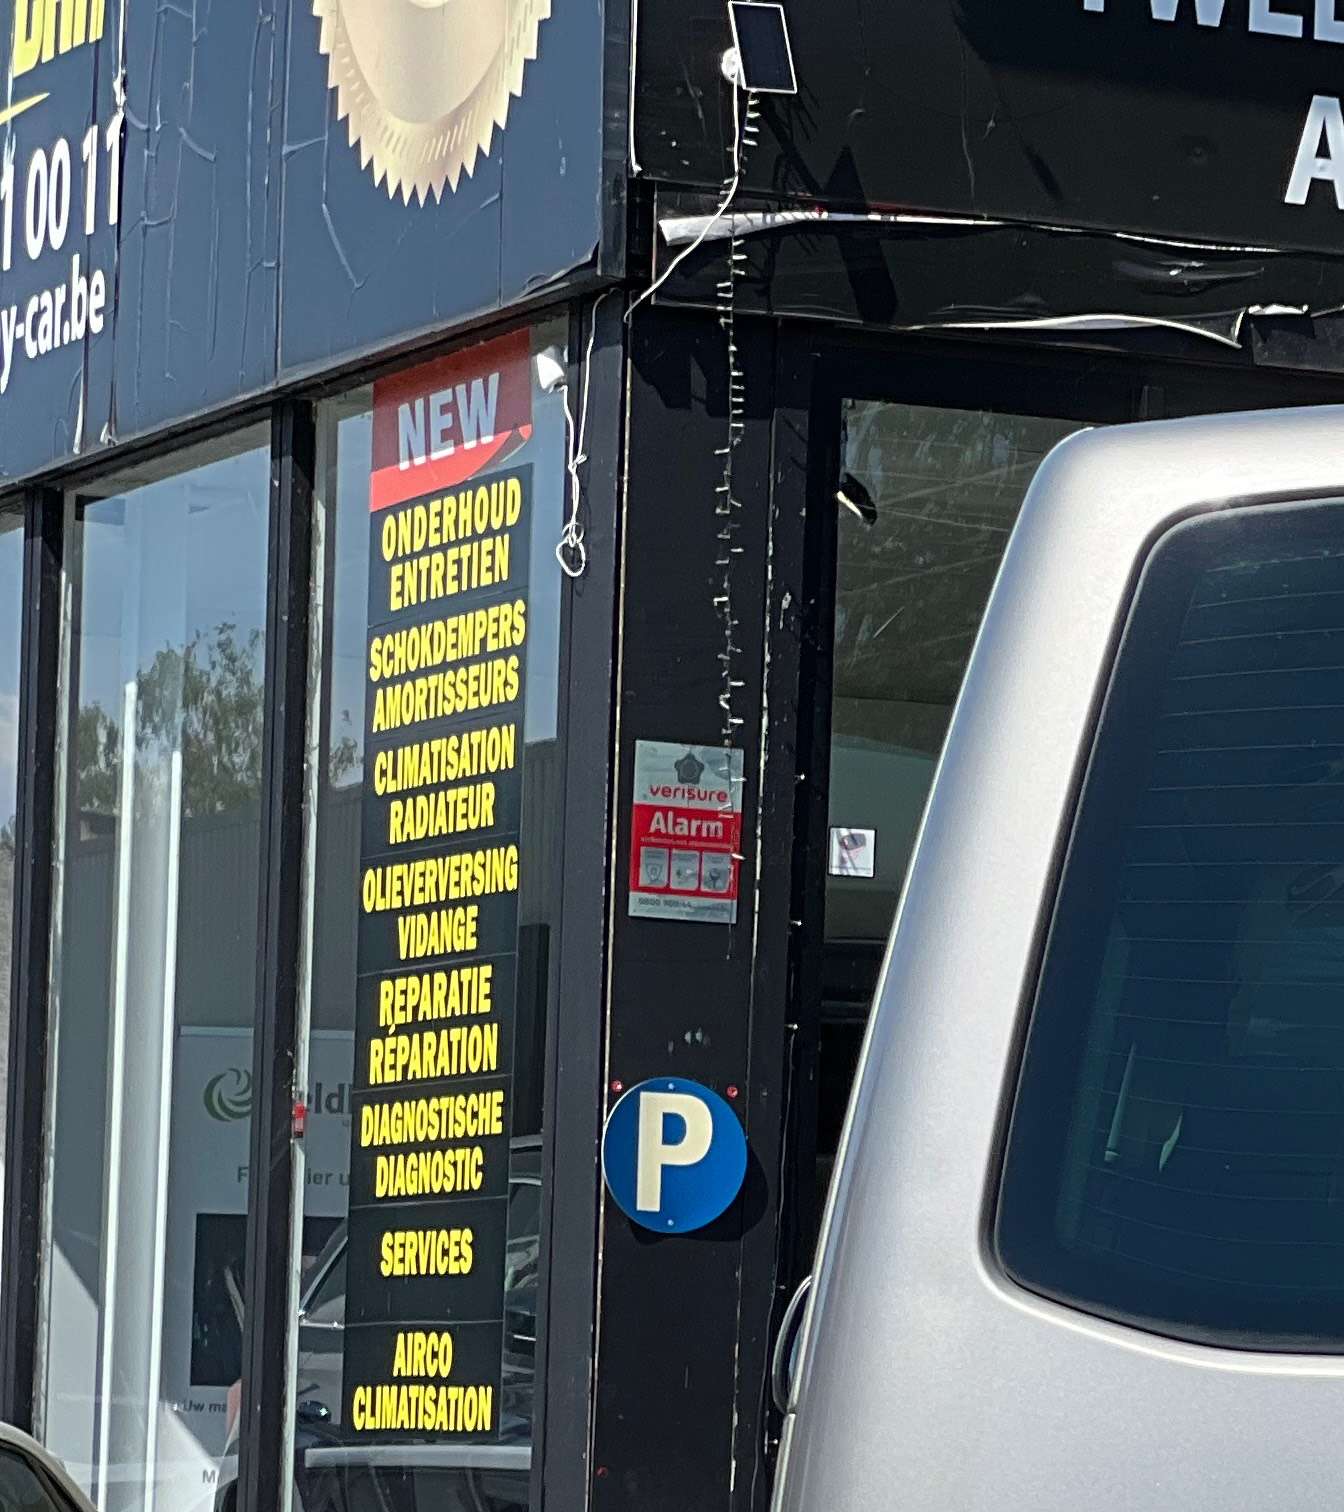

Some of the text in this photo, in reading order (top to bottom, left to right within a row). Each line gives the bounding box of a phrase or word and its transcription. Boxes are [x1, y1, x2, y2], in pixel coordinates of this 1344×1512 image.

[26, 137, 71, 260] 00
[398, 372, 500, 470] NEW
[382, 478, 522, 562] ONDERHOUD
[390, 533, 510, 612] ENTRETIEN
[369, 599, 527, 682] SCHOKDEMPERS
[372, 655, 520, 733] AMORTISSEURS
[374, 723, 516, 796] CLIMATISATION
[389, 782, 496, 845] RADIATEUR
[650, 783, 729, 803] verisure
[650, 811, 723, 840] Alarm
[363, 845, 519, 913] OLIEVERVERSING
[398, 905, 479, 960] VIDANGE
[379, 965, 493, 1027] REPARATIE
[369, 1022, 498, 1085] RÉPARATION
[361, 1090, 504, 1148] DIAGNOSTISCHE
[375, 1146, 484, 1198] DIAGNOSTIC
[636, 1090, 714, 1213] P
[380, 1228, 473, 1277] SERVICES
[393, 1331, 453, 1378] AIRCO
[353, 1385, 493, 1432] CLIMATISATION
